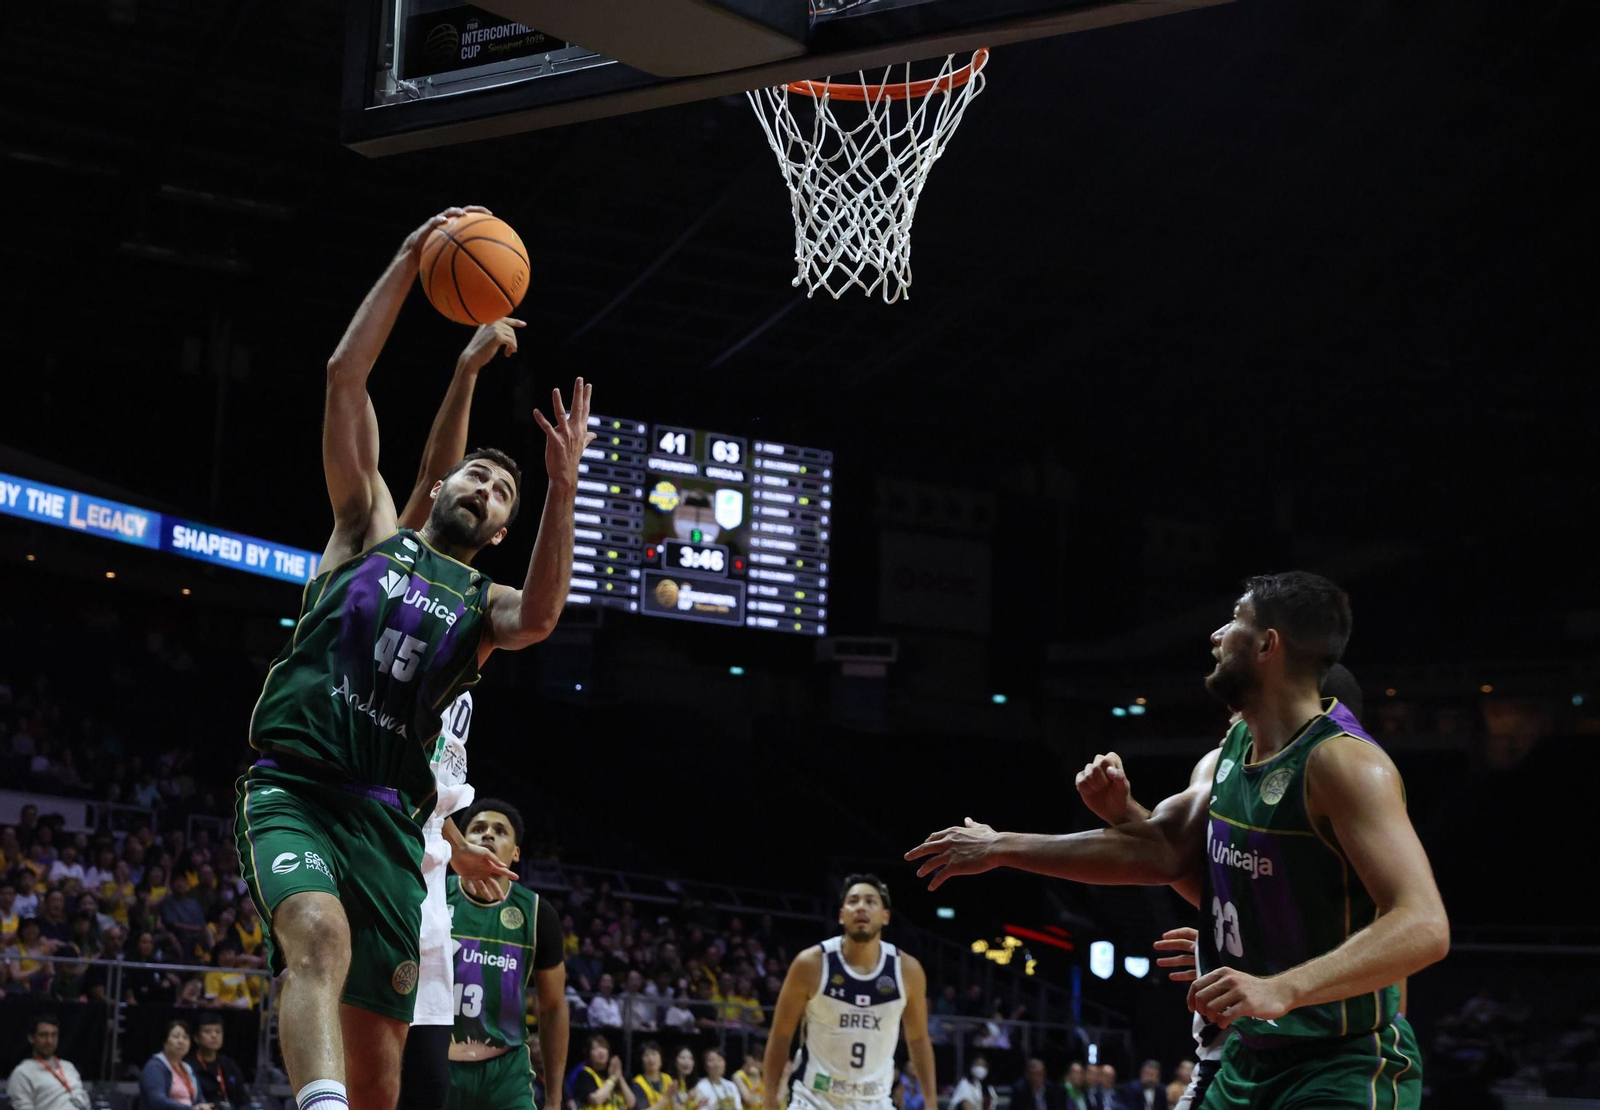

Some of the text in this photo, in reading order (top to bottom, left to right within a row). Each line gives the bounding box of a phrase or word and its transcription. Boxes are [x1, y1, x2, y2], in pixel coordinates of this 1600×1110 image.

[461, 45, 481, 60] CUP
[659, 431, 686, 456] 41
[712, 440, 740, 465] 63
[26, 487, 65, 519] THE
[172, 524, 243, 563] SHAPED
[245, 543, 271, 569] BY
[273, 549, 306, 579] THE
[679, 546, 725, 572] 3:46
[402, 587, 458, 634] Unica
[374, 626, 429, 683] 45
[1212, 838, 1273, 880] Unicaja
[1212, 896, 1243, 958] 33
[462, 948, 518, 972] Unicaja
[454, 983, 484, 1018] 13
[839, 1013, 881, 1031] BREX
[850, 1042, 866, 1069] 9
